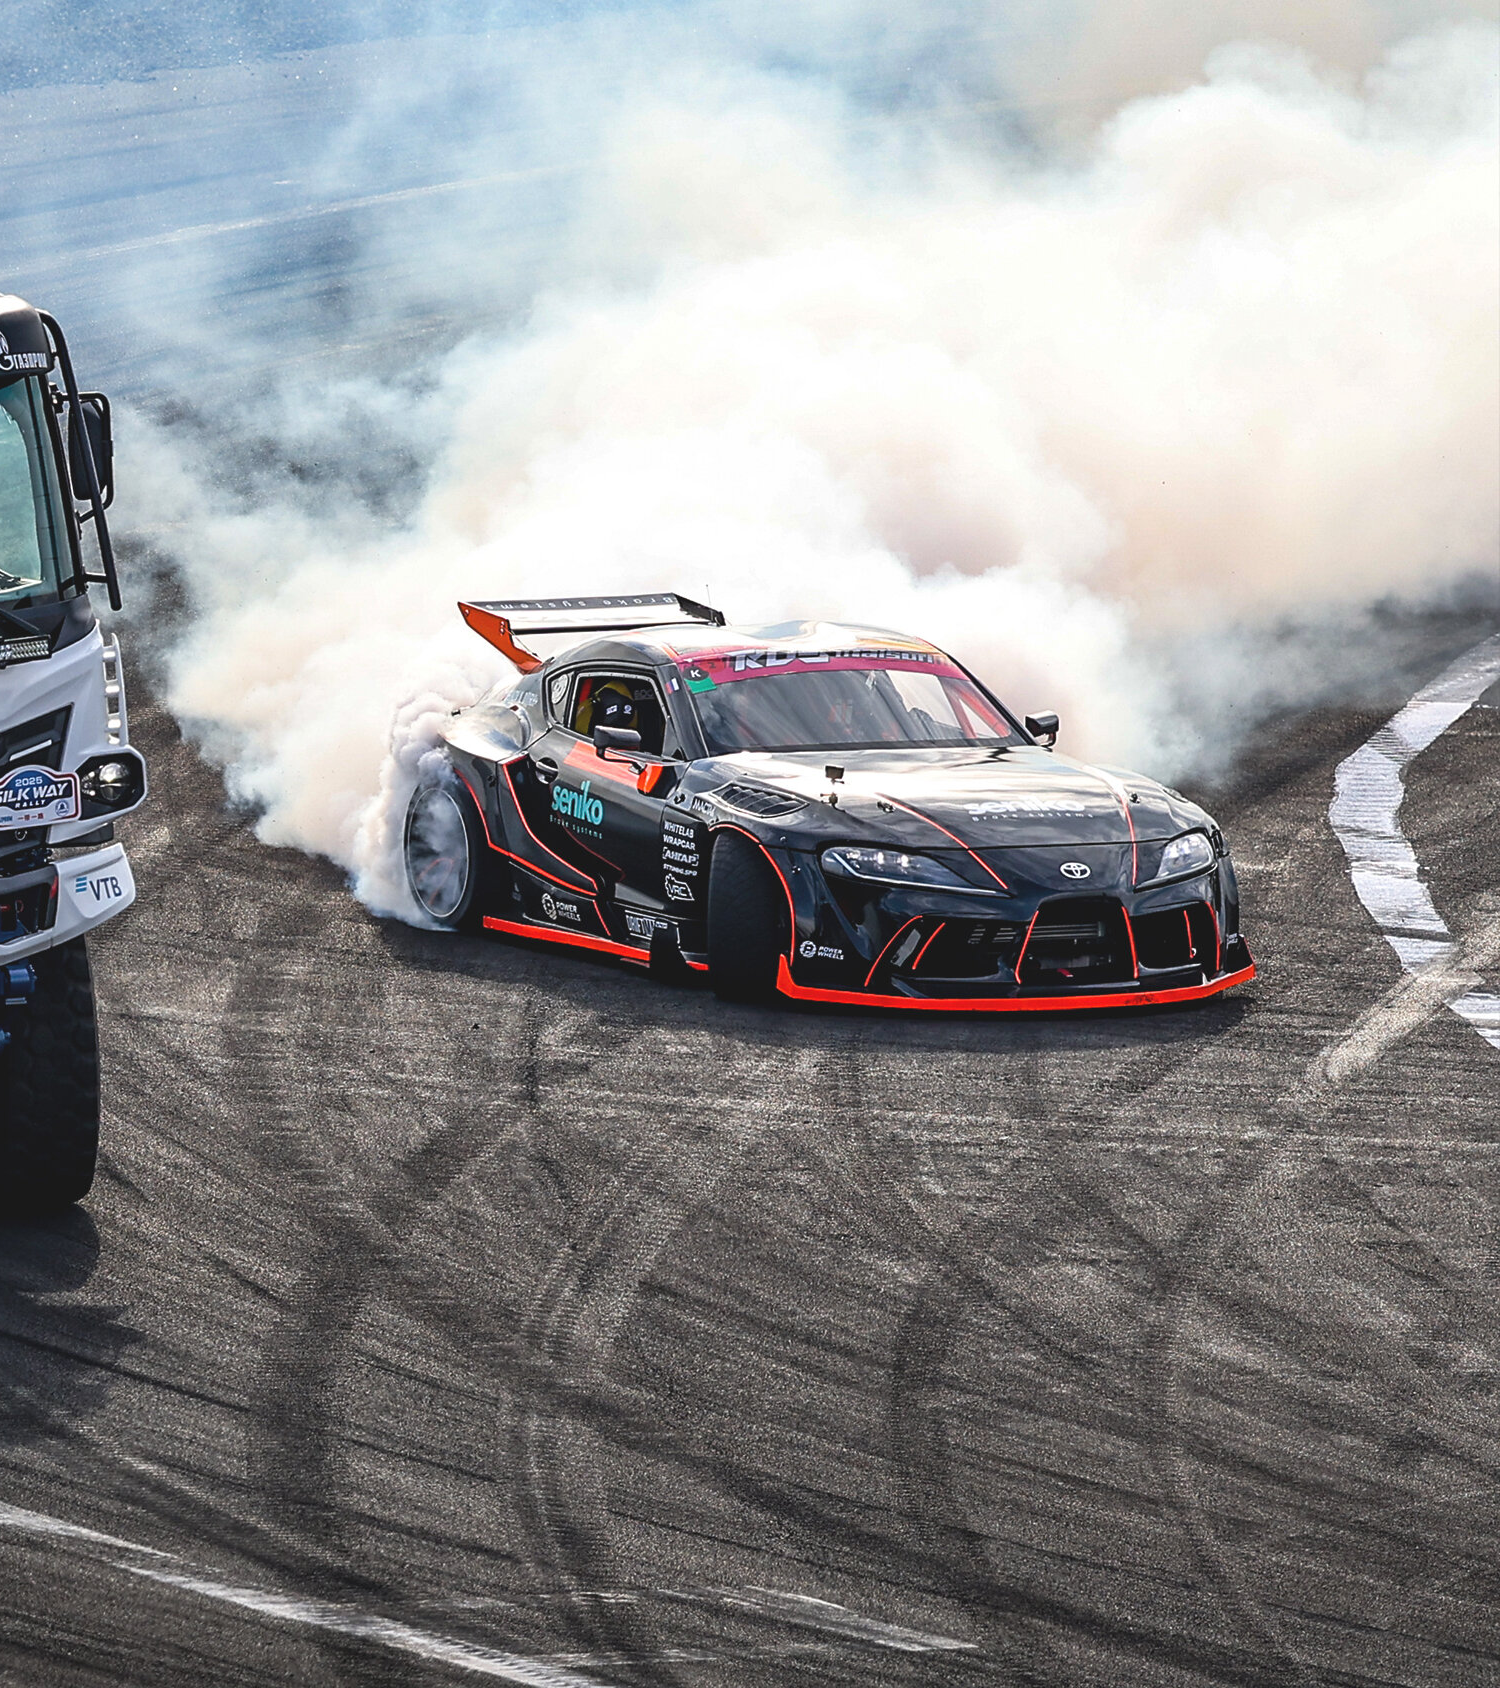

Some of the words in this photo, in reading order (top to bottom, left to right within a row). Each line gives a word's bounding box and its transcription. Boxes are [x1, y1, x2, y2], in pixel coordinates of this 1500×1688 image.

[14, 353, 48, 370] ГАЗПРОМ
[15, 776, 43, 787] 2025
[33, 782, 68, 799] WAY
[15, 800, 46, 809] RALLY
[551, 780, 604, 826] seniko
[963, 796, 1086, 815] seniko
[664, 820, 695, 839] WHITELAB
[663, 834, 696, 850] WRAPCAR
[88, 876, 122, 901] VTB
[555, 901, 578, 914] POWER
[817, 951, 845, 960] WHEELS
[818, 945, 843, 954] POWER
